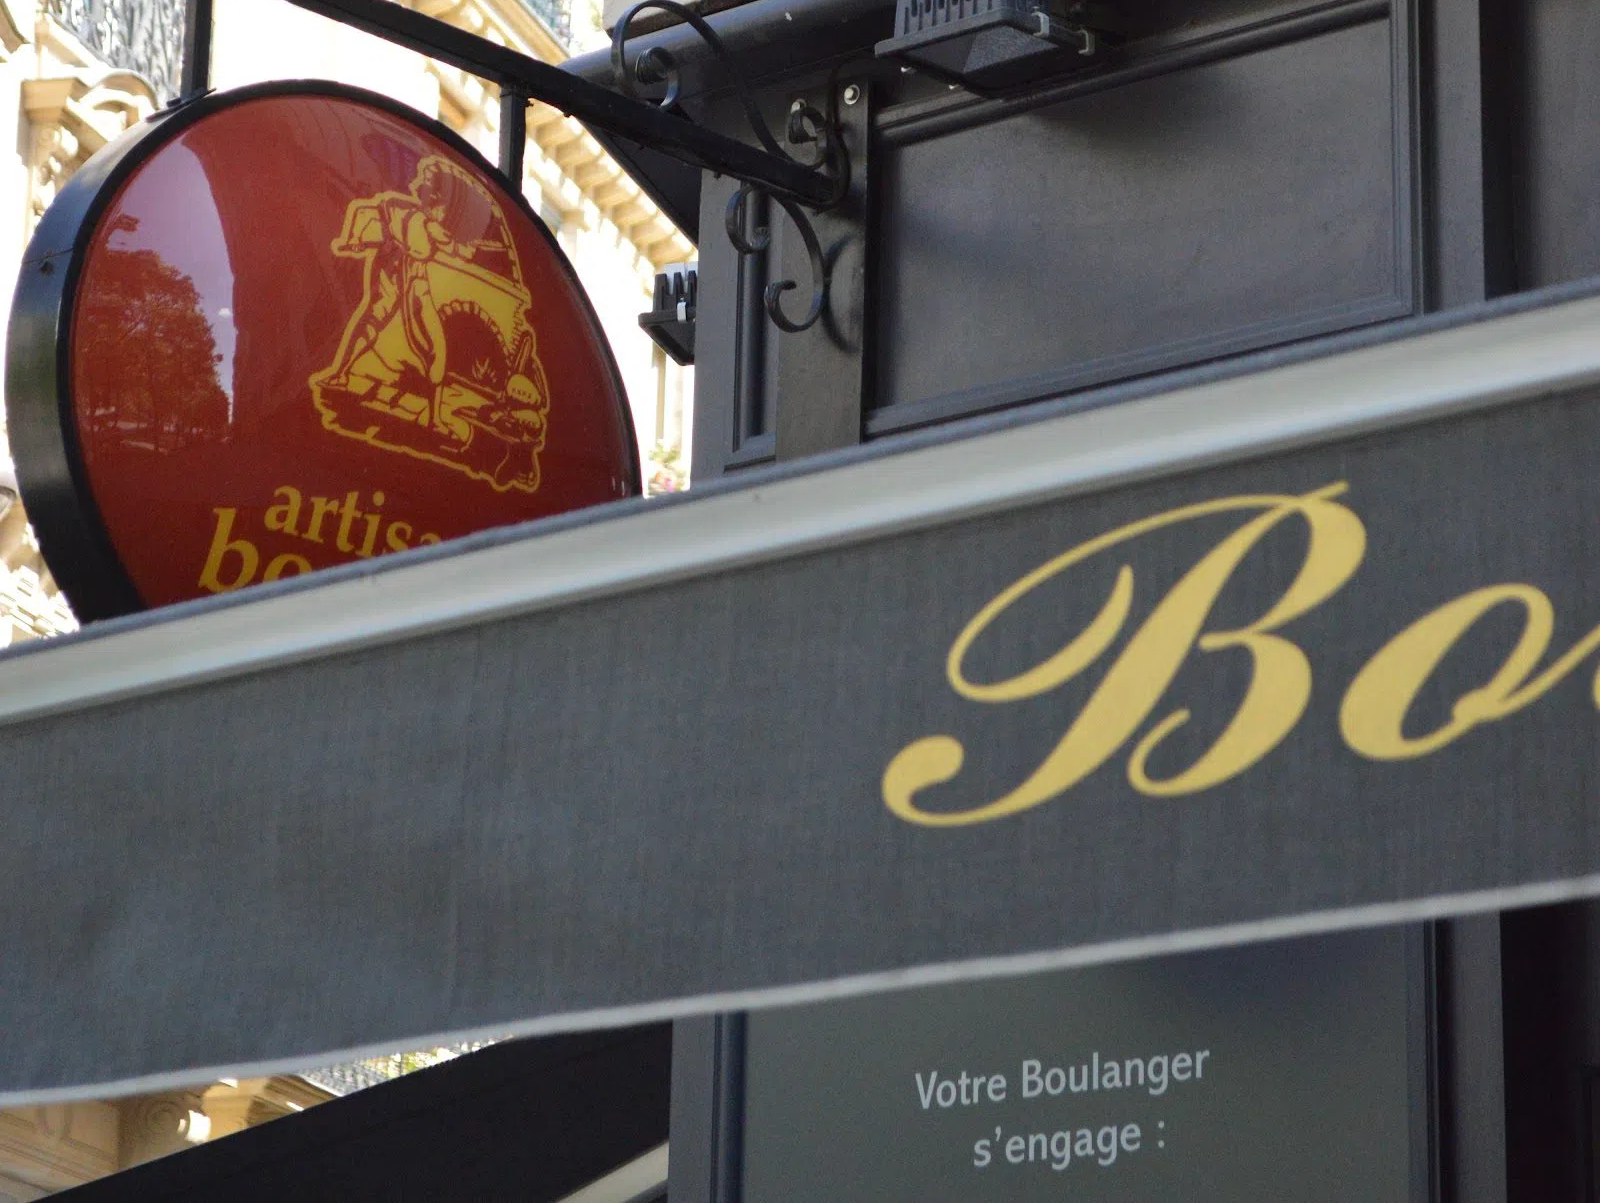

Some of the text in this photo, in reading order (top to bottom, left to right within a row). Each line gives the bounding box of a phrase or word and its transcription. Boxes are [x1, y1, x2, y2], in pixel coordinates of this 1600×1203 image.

[882, 480, 1600, 828] Bo
[914, 1050, 1210, 1110] Votre Boulanger
[973, 1122, 1141, 1171] s'engage
